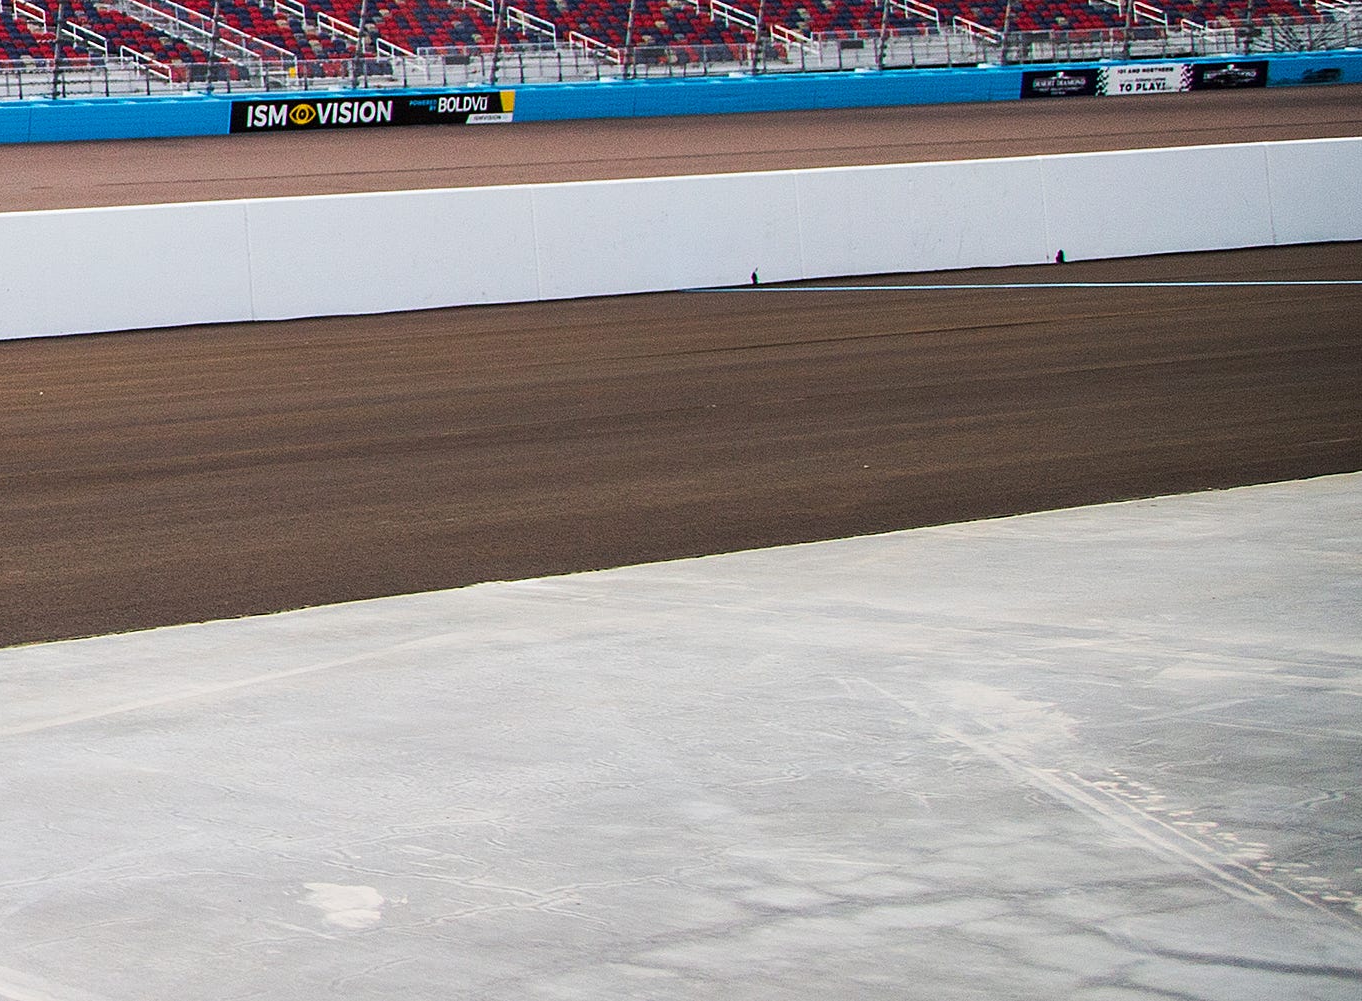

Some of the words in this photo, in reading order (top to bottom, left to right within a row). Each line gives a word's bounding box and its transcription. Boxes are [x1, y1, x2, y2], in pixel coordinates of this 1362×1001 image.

[1118, 83, 1131, 92] TO
[1135, 82, 1167, 92] PLAY!
[246, 105, 288, 127] ISM
[316, 100, 393, 124] VISION
